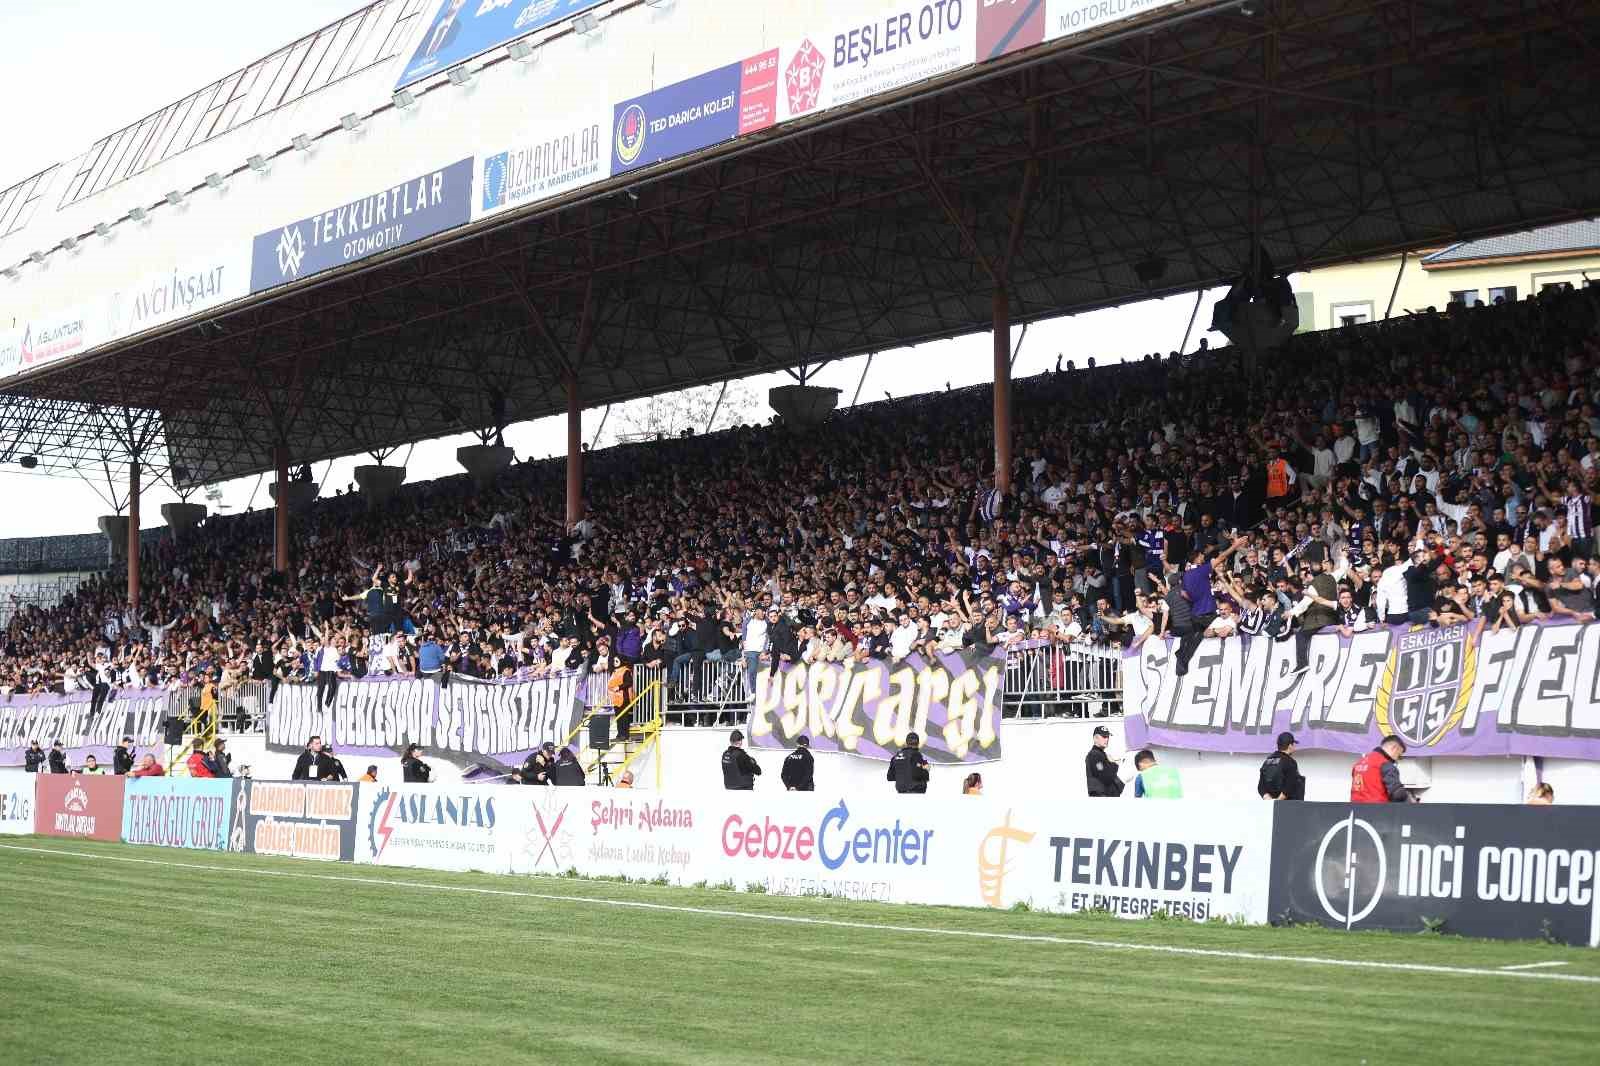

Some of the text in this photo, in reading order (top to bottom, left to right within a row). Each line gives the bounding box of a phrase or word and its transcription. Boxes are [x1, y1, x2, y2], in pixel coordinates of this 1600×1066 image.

[833, 9, 913, 69] BEŞLER
[919, 0, 962, 39] OTO
[649, 121, 666, 134] TED
[668, 112, 702, 131] DARICA
[703, 90, 735, 116] KOLEJİ
[312, 171, 443, 246] TEKKURTLAR
[172, 265, 225, 311] İNŞAAT
[1140, 631, 1391, 731] SIEMPRE
[397, 794, 496, 835] ASLANTAŞ
[591, 799, 693, 836] Şehri Adana
[722, 798, 934, 870] Gebze Center
[1049, 836, 1244, 894] TEKİNBEY
[1398, 824, 1465, 899] inci
[1072, 892, 1211, 920] ET ENTEGRE TESİSİ
